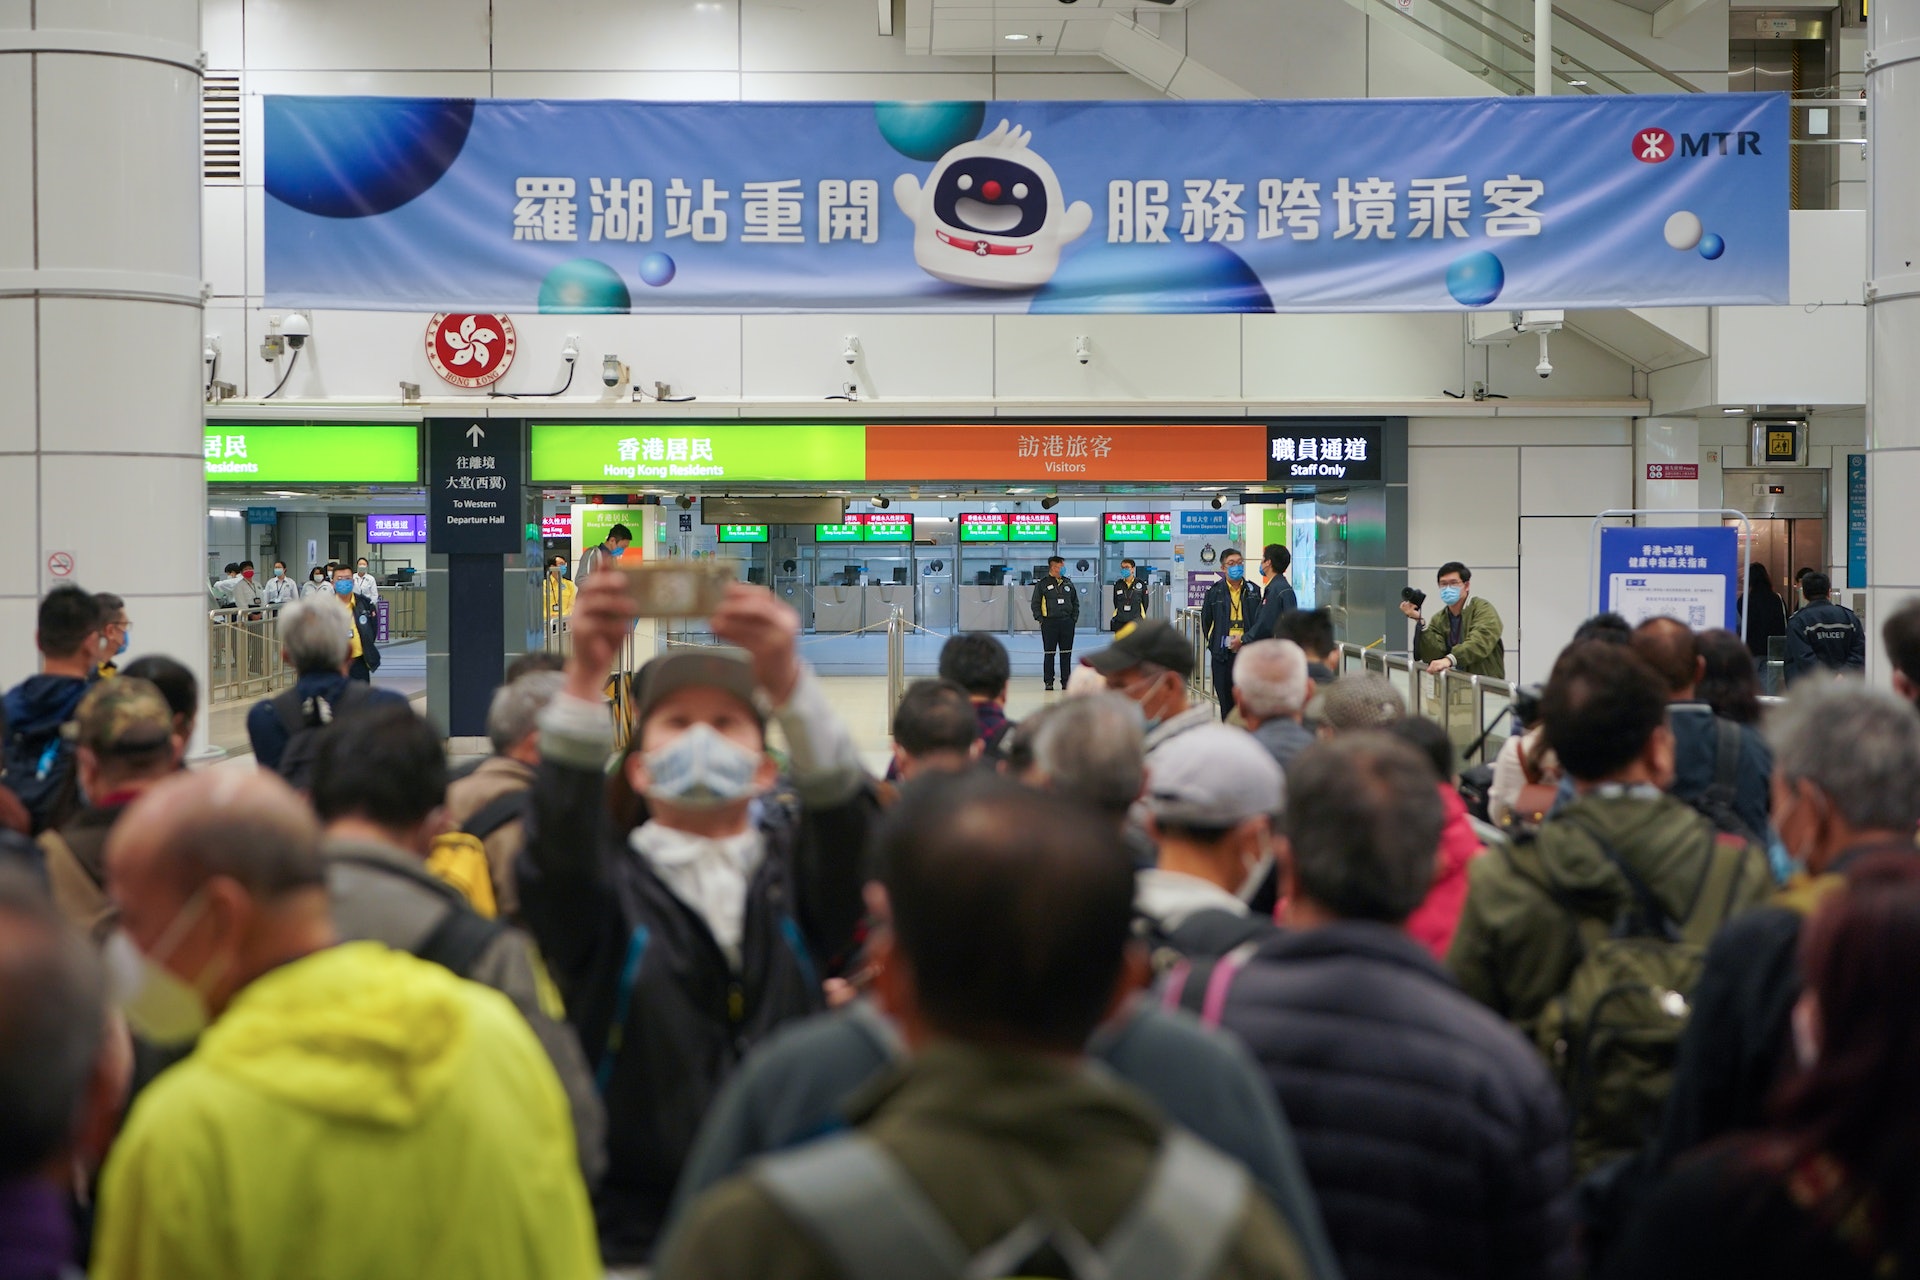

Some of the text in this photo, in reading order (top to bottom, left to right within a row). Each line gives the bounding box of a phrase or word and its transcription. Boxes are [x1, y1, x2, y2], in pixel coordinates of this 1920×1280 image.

[1680, 131, 1762, 157] MTR
[512, 174, 1546, 244] 羅湖站重開 服務跨境乘客
[445, 372, 470, 387] HONG
[617, 437, 713, 461] 香港居民
[1018, 435, 1112, 458] 訪港旅客
[1271, 437, 1368, 461] 職員通道
[456, 456, 496, 469] 往離境
[1045, 462, 1086, 472] Visitors
[603, 464, 724, 478] Hong Kong Residents
[1291, 464, 1346, 478] Staff Only
[445, 475, 507, 491] 大堂(西翼)
[453, 500, 497, 508] To Western
[447, 516, 505, 525] Departure Hall
[1628, 557, 1707, 569] 健康申报通关指南
